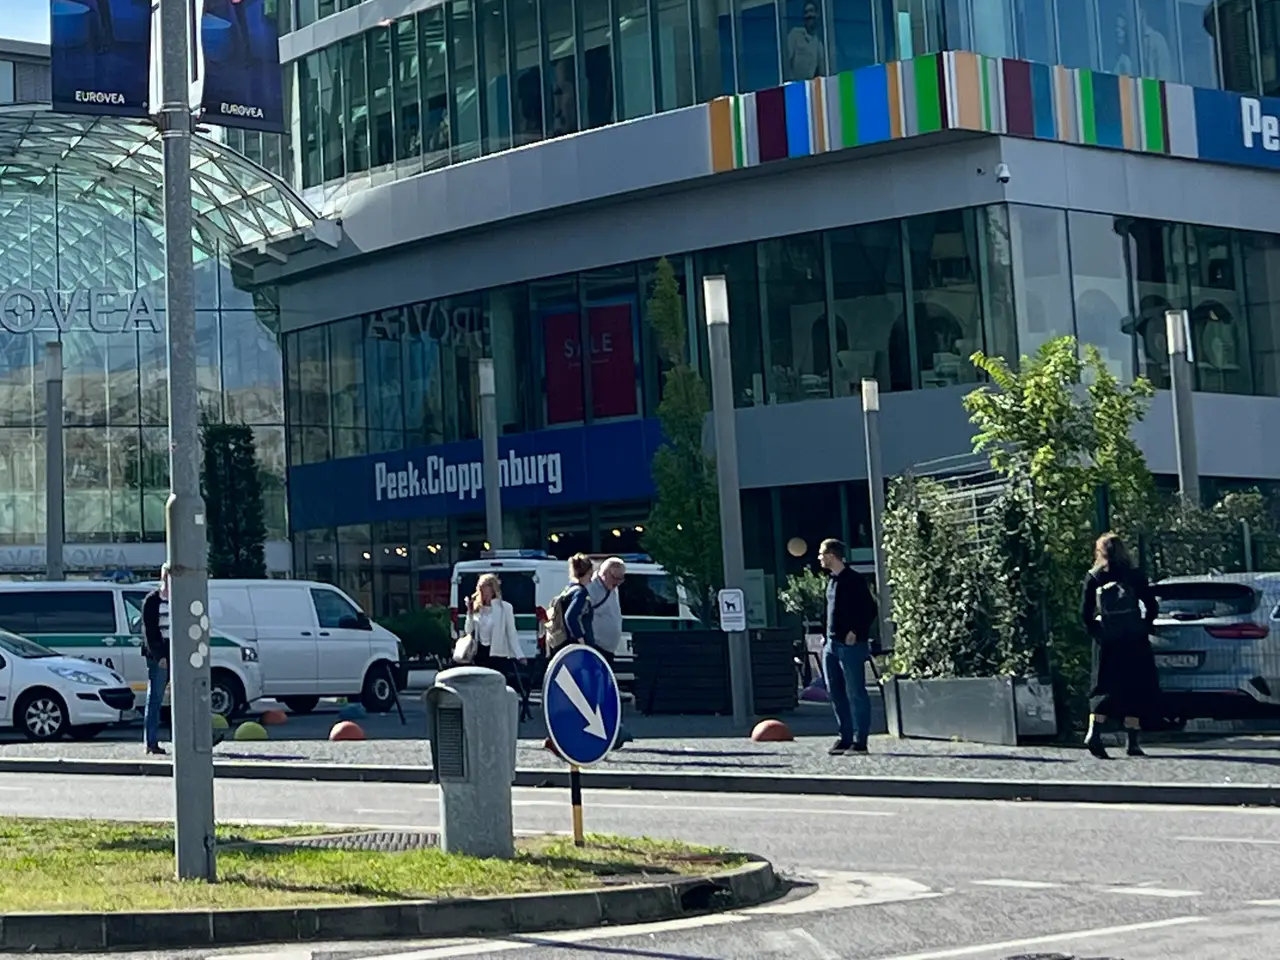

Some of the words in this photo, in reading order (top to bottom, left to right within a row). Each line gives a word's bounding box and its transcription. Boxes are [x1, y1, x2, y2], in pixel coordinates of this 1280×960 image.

[75, 89, 125, 105] EUROVEA
[220, 102, 264, 119] EUROVEA
[375, 449, 563, 502] Peek&Cloppnburg
